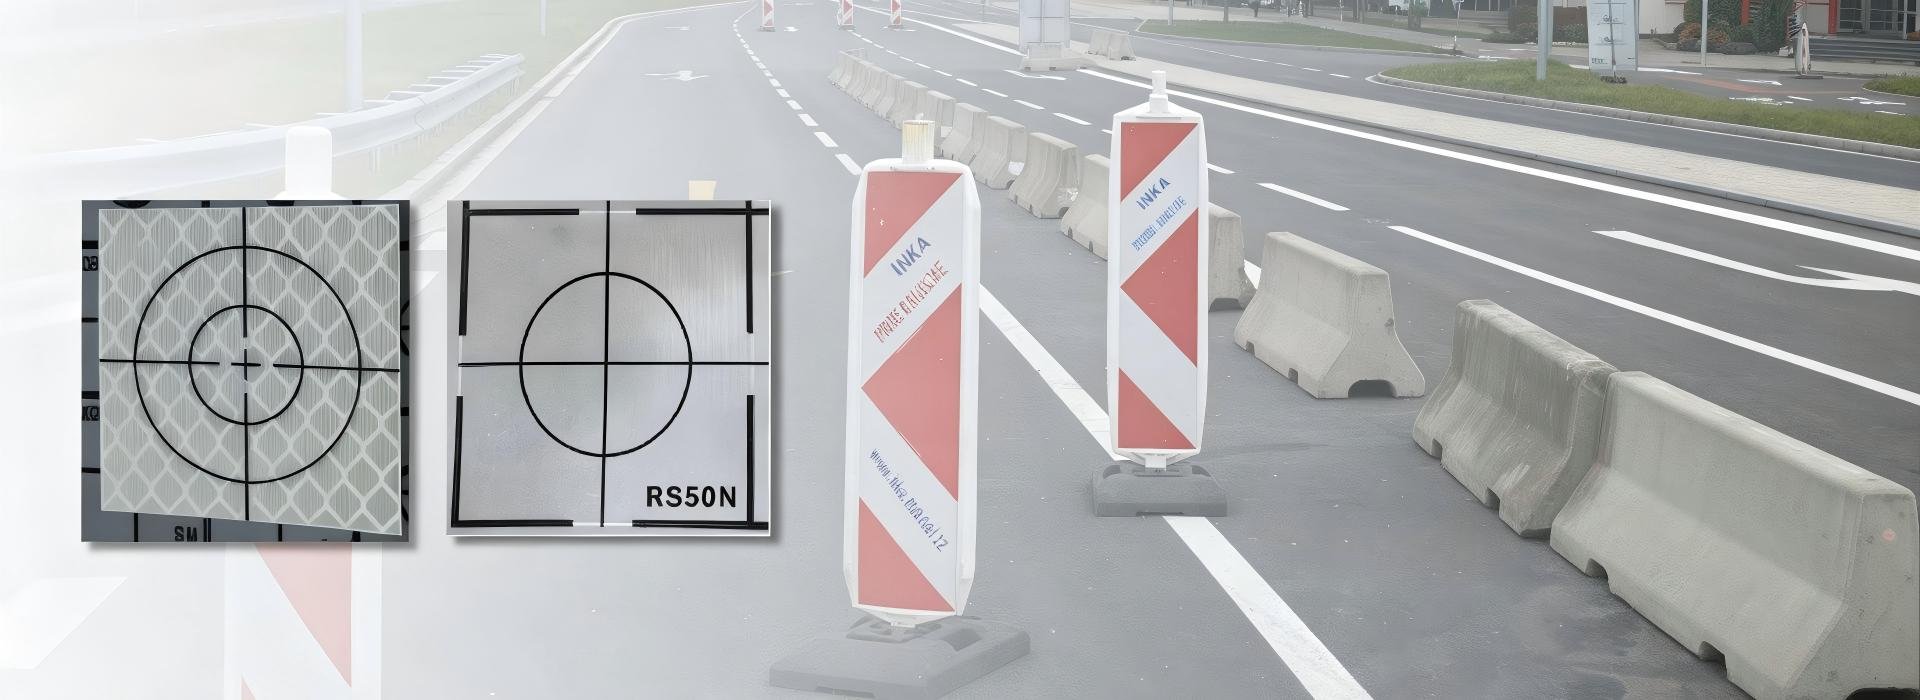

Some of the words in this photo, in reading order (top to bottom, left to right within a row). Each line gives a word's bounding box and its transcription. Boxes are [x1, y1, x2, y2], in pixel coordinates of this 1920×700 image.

[1136, 177, 1171, 210] INKA
[890, 237, 931, 276] INKA
[646, 485, 736, 508] RS50N
